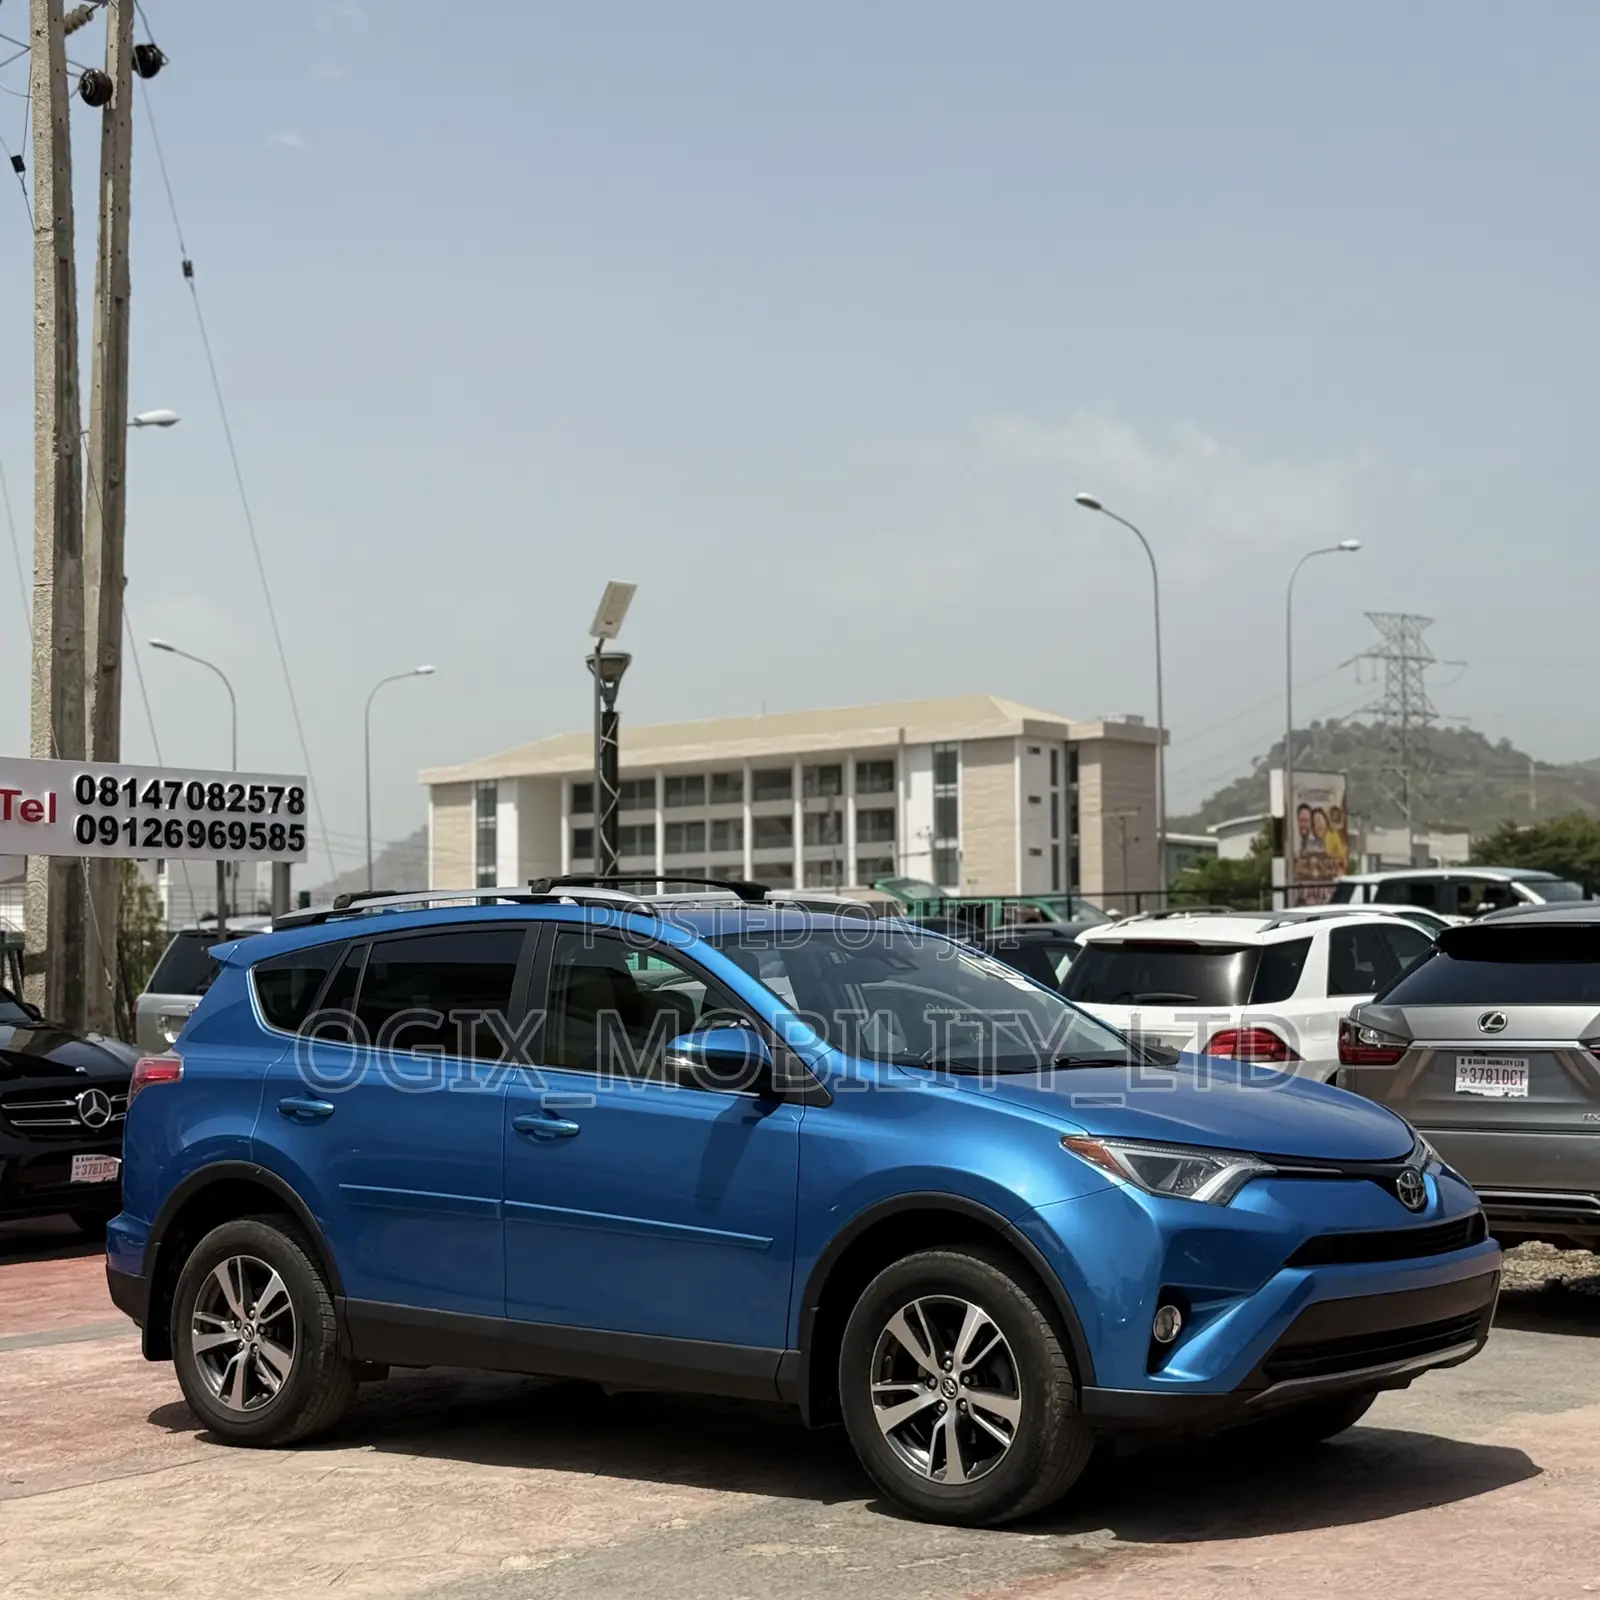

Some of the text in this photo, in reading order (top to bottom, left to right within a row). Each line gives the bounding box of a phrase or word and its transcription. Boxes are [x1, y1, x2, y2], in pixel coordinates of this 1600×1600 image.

[0, 788, 56, 823] Tel
[74, 774, 305, 815] 08147082578
[74, 813, 305, 852] 09126969585
